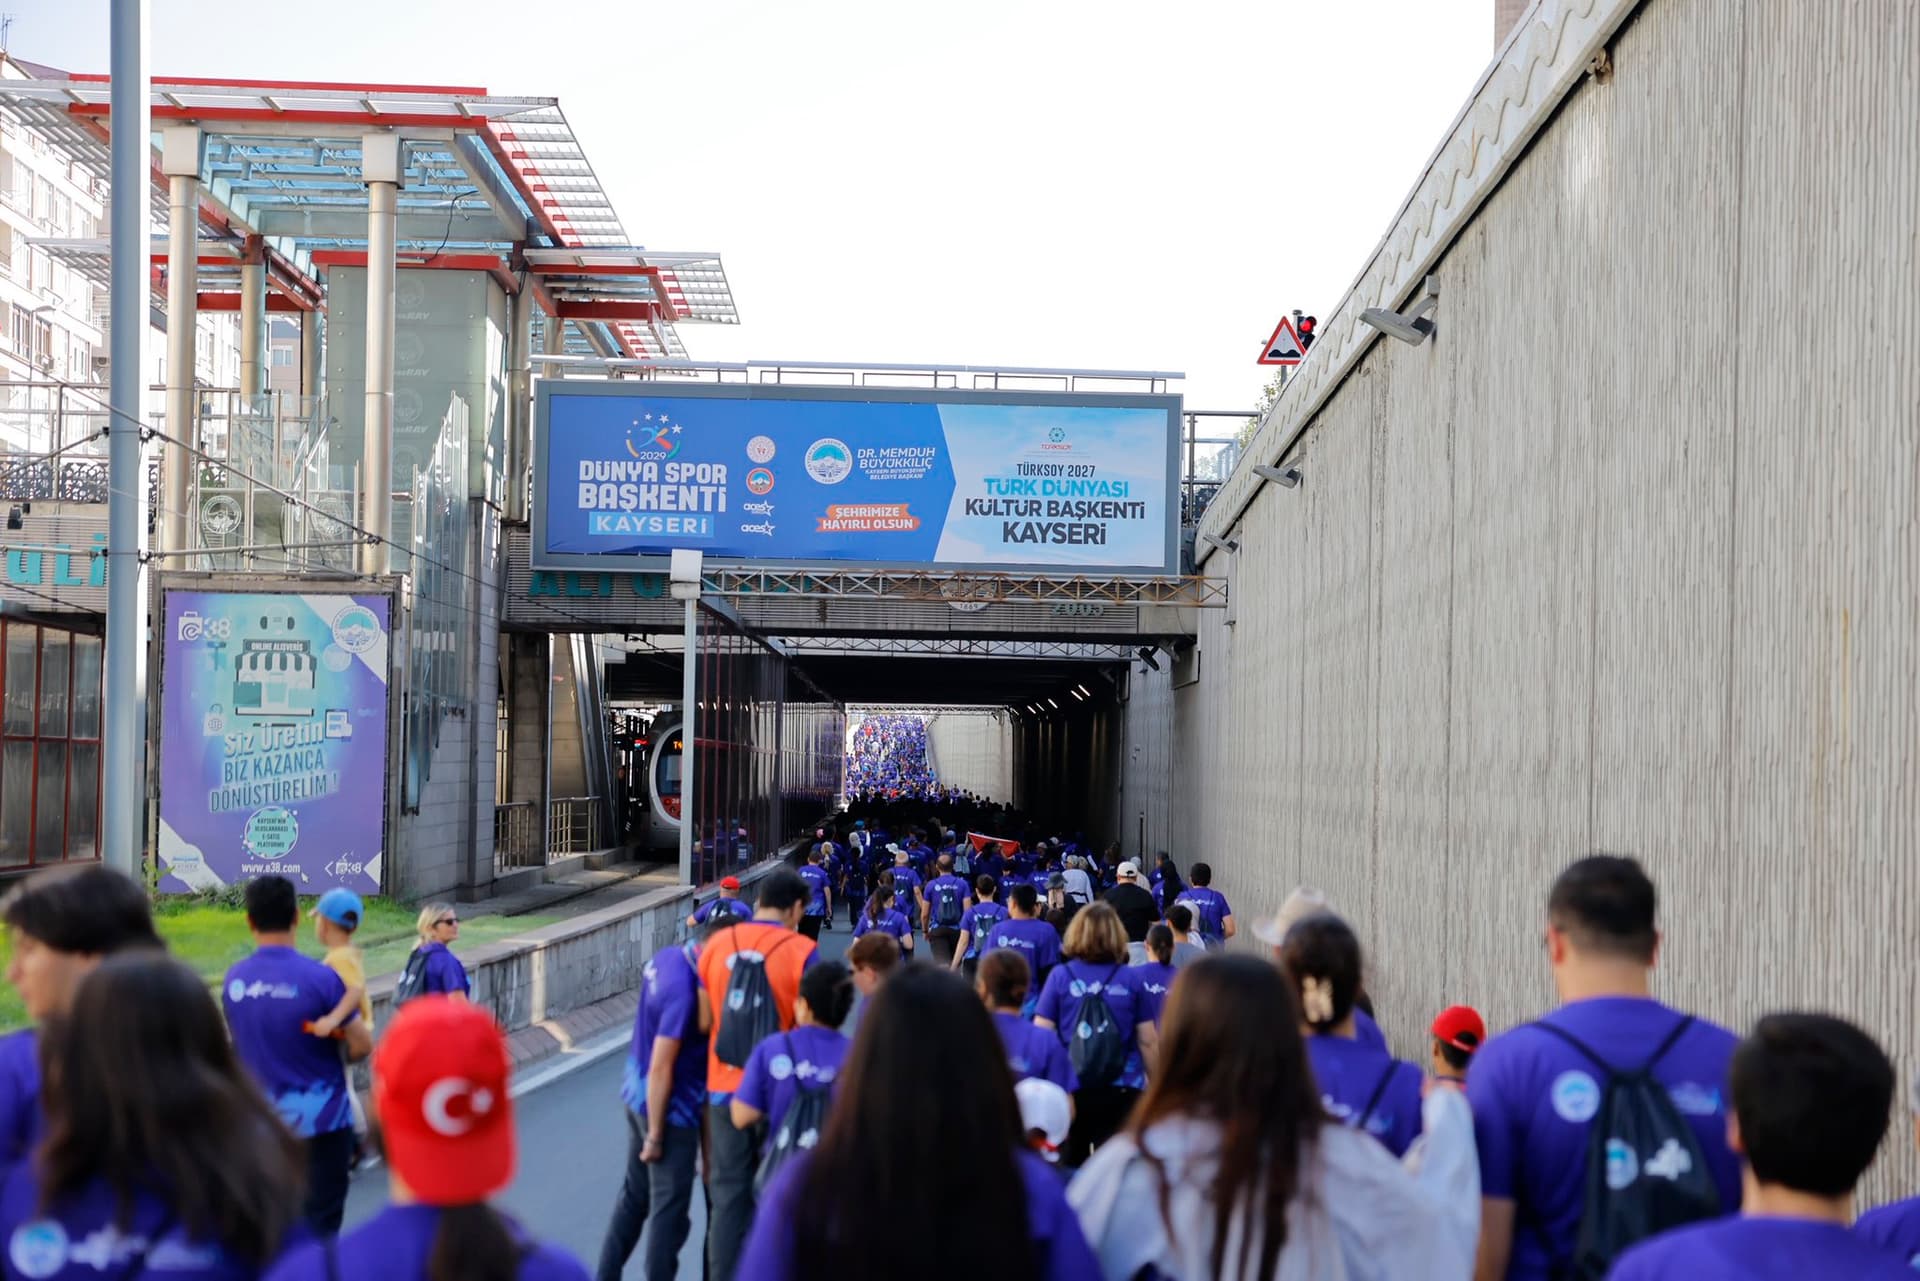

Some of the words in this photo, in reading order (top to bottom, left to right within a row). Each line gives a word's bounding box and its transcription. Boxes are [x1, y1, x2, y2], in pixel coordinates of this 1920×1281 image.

[640, 452, 666, 460] 2029
[857, 448, 878, 459] DR.
[879, 447, 936, 458] MEMDUH
[579, 460, 659, 482] DÜNYA
[664, 463, 728, 485] SPOR
[859, 457, 933, 470] BÜYÜKKILIÇ
[1016, 462, 1064, 477] TÜRKSOY
[1067, 465, 1096, 477] 2027
[984, 478, 1038, 496] TÜRK
[1042, 479, 1129, 498] DÜNYASI
[578, 483, 727, 513] BAŞKENTİ
[835, 506, 900, 519] ŞEHRİMİZE
[965, 498, 1042, 517] KÜLTÜR
[1047, 500, 1145, 521] BAŞKENTİ
[596, 515, 707, 534] KAYSERİ
[822, 519, 870, 529] HAYIRLI
[873, 519, 913, 529] OLSUN
[1003, 521, 1106, 545] KAYSERİ
[259, 721, 325, 753] Üretin
[224, 757, 249, 783] BİZ
[253, 748, 324, 780] KAZANCA
[242, 862, 300, 873] www.e38.com
